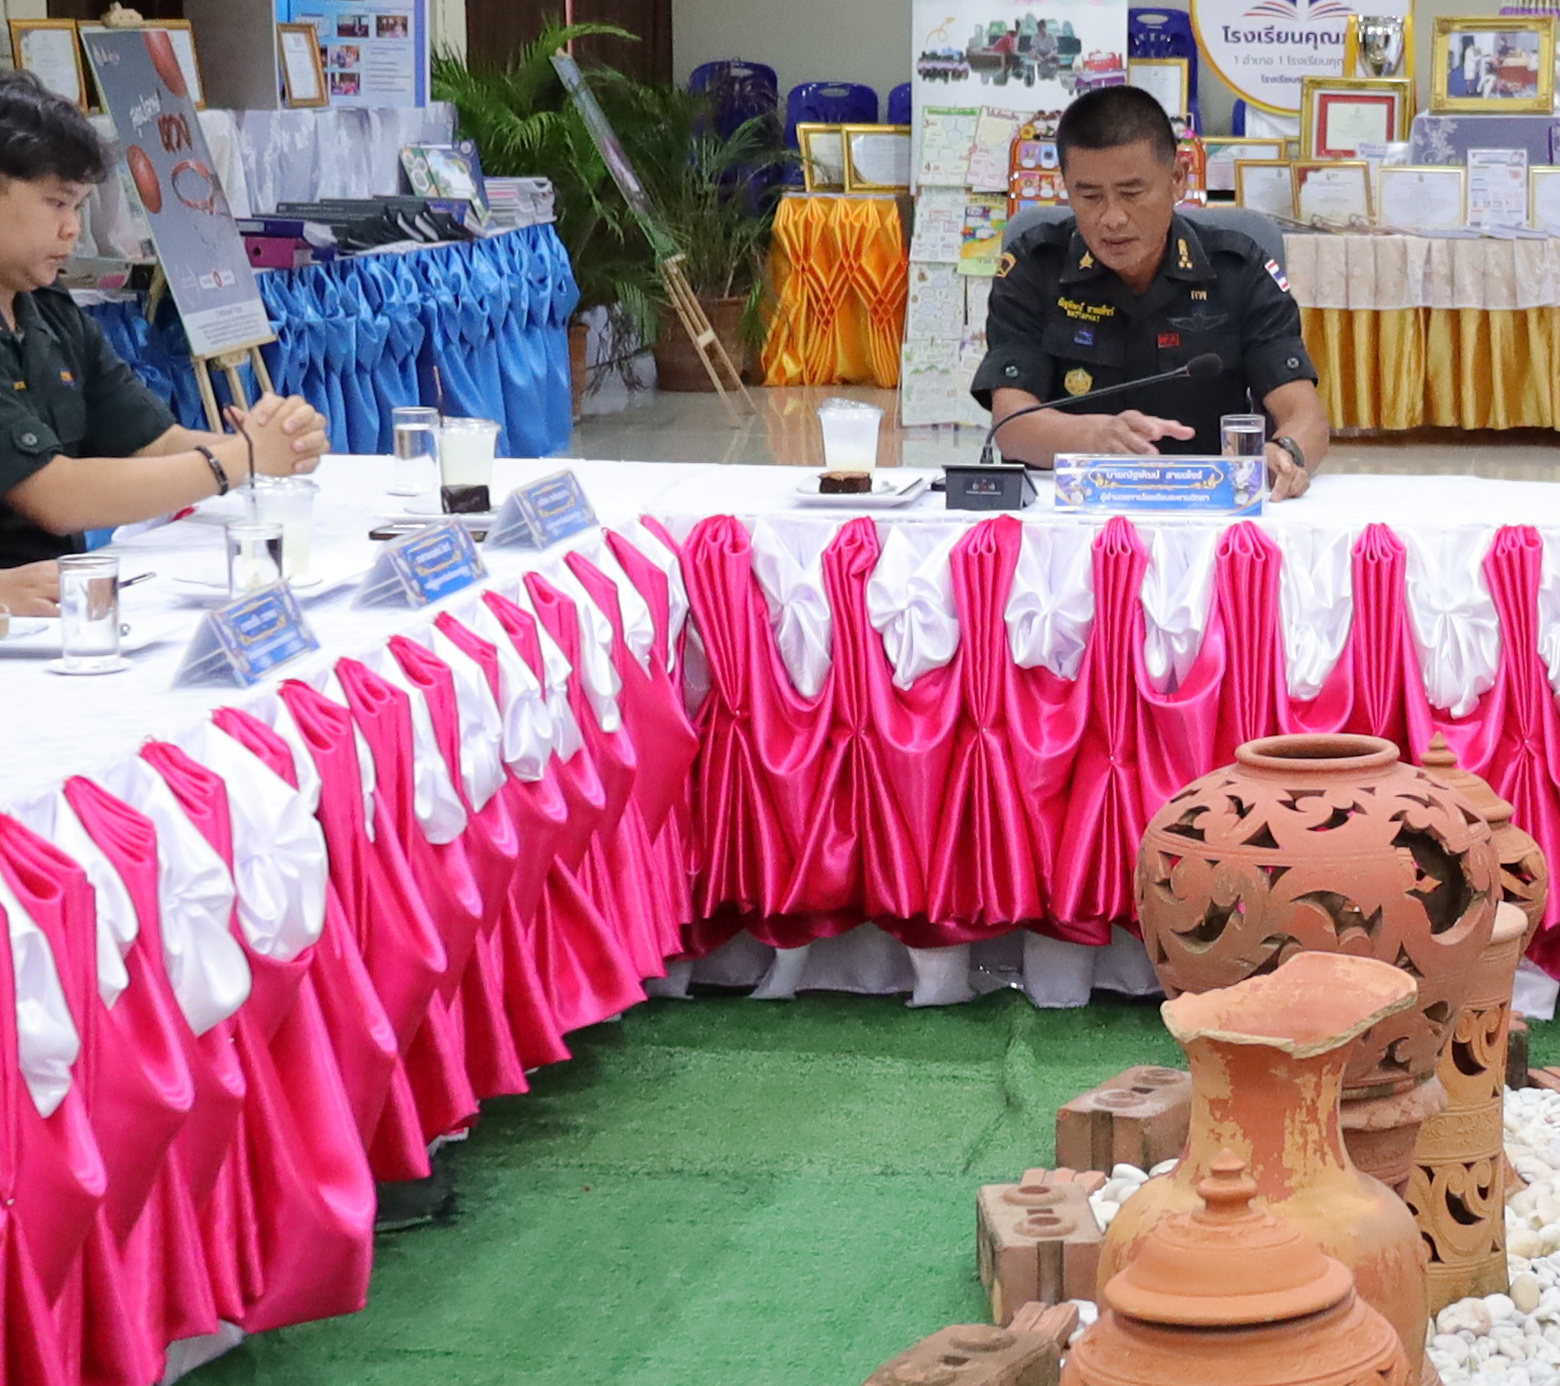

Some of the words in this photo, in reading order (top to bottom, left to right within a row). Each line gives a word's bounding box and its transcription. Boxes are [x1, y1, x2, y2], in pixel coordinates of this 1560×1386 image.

[1222, 25, 1347, 50] โรงเรียนคุณ
